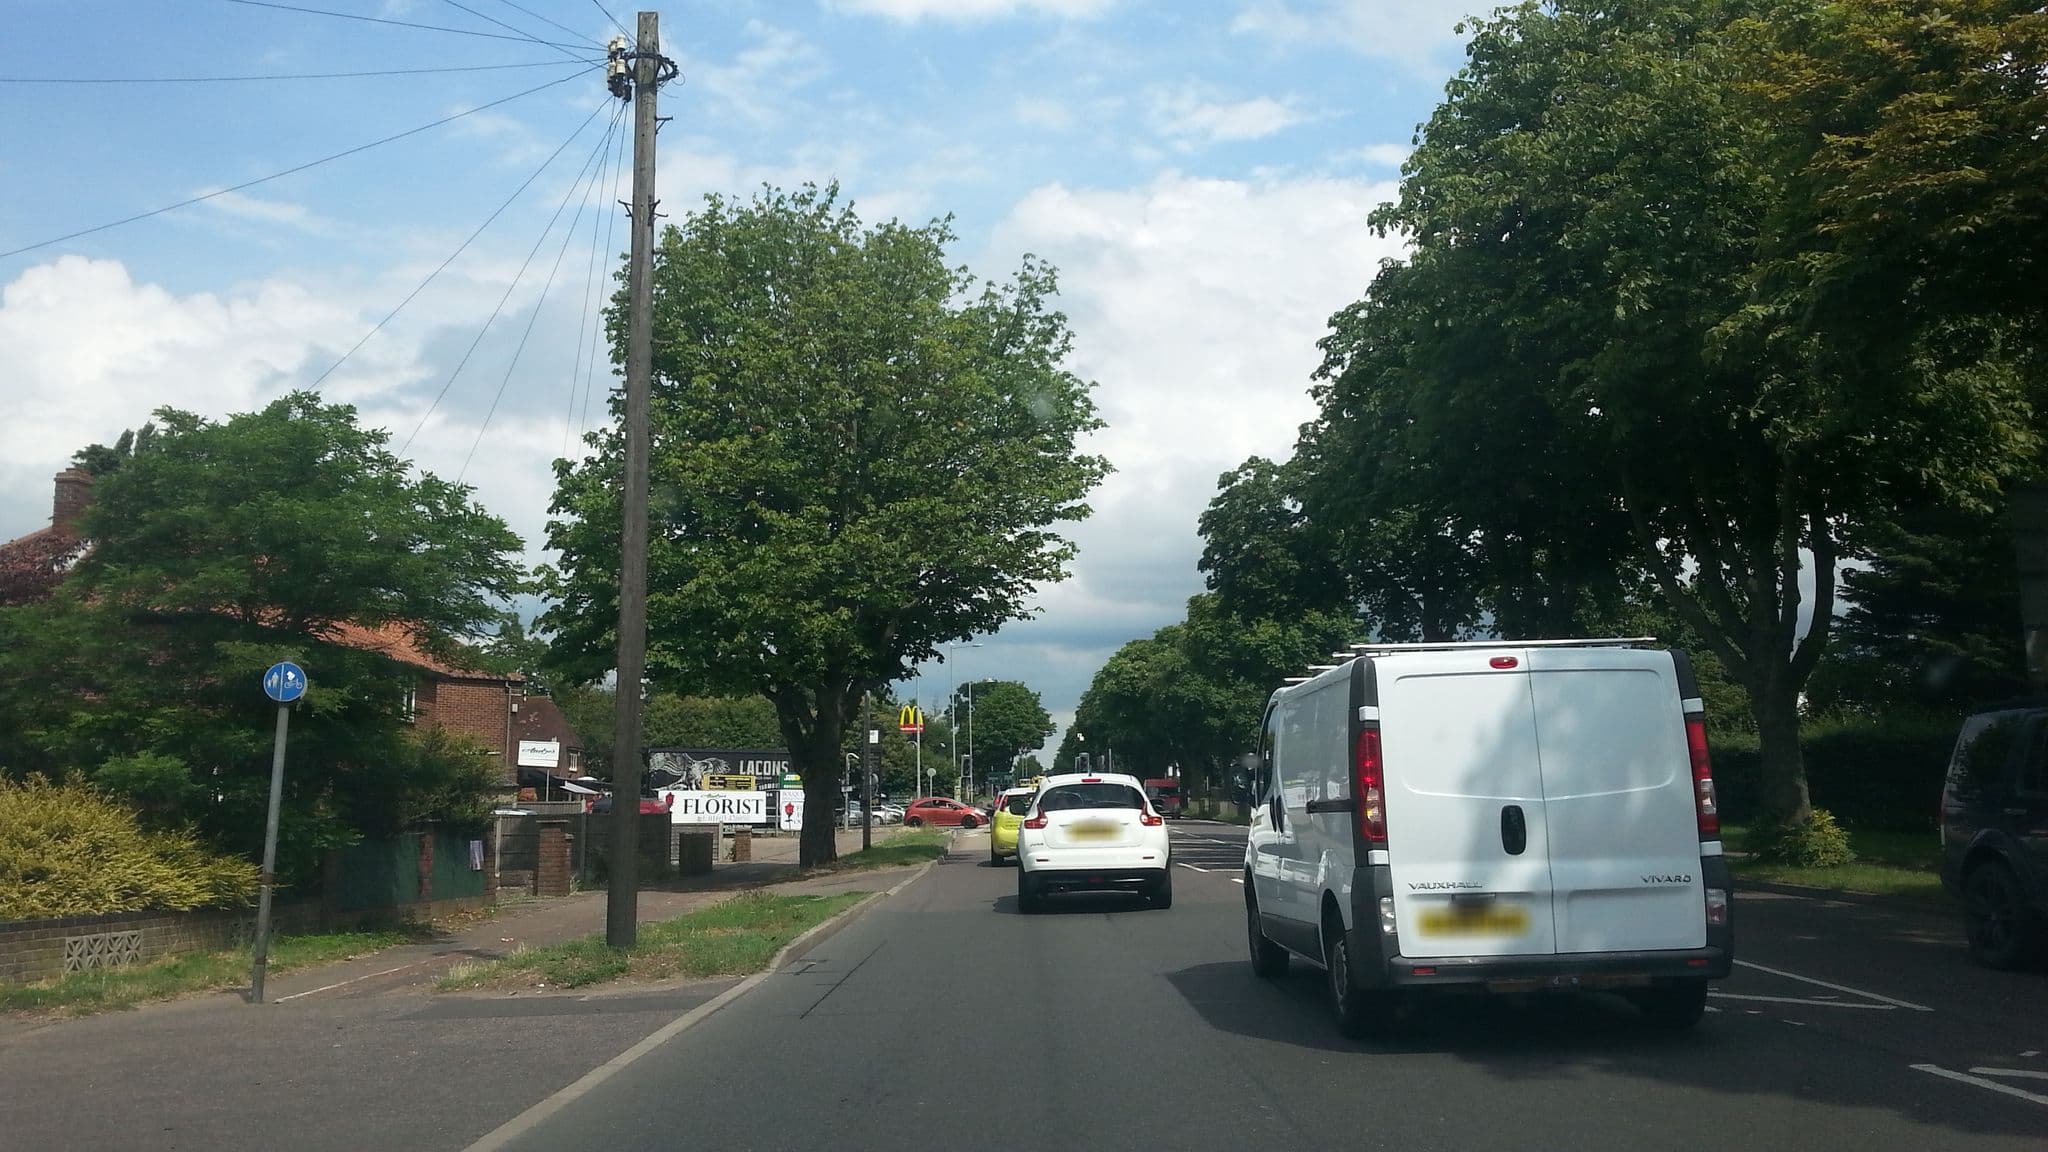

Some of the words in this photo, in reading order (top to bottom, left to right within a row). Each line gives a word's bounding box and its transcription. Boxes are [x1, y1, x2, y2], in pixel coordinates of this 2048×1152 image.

[739, 760, 789, 777] LACONS
[683, 798, 763, 814] FLORIST
[1407, 880, 1483, 891] VAUXHALL
[1641, 874, 1692, 884] VIVARO
